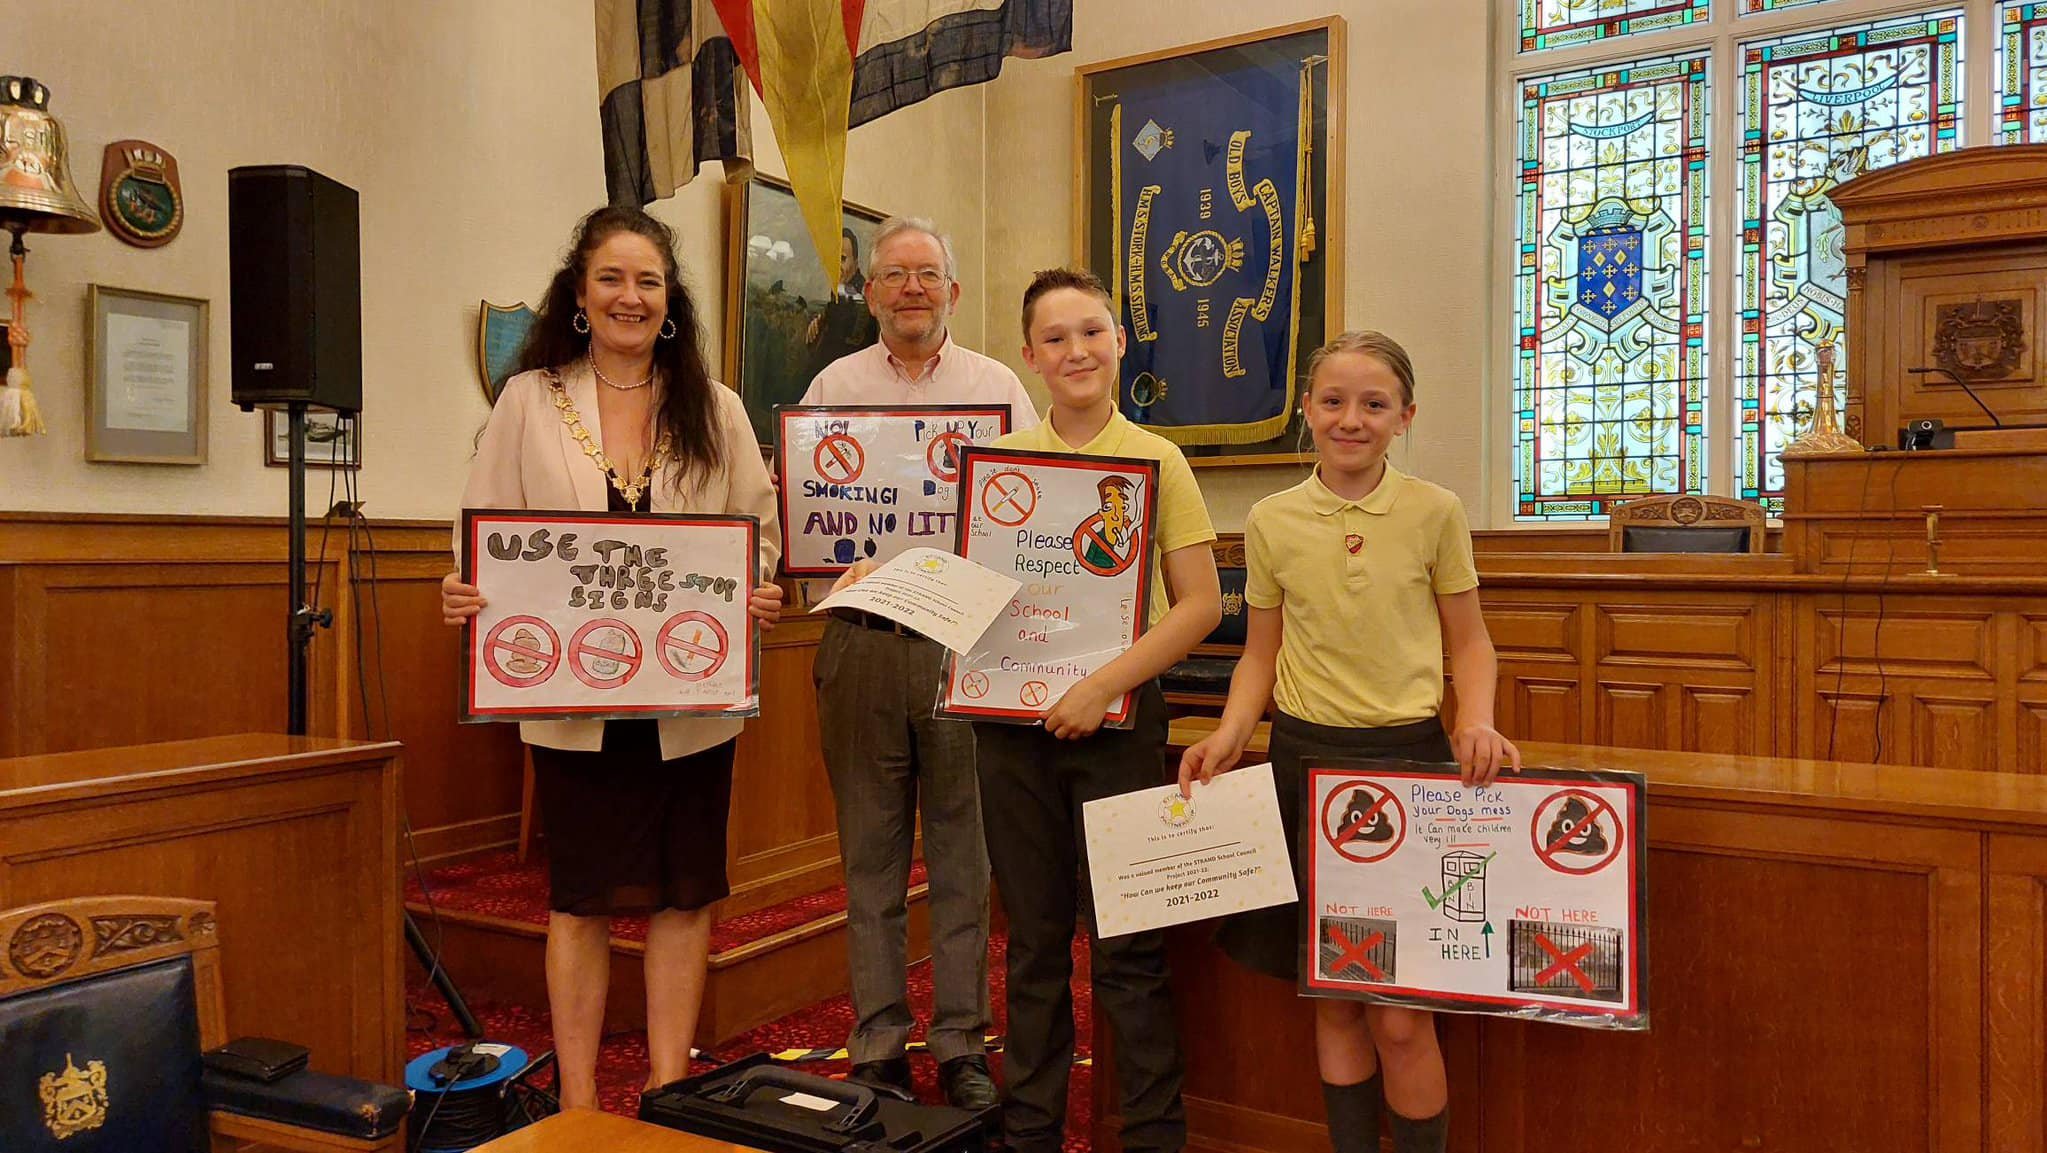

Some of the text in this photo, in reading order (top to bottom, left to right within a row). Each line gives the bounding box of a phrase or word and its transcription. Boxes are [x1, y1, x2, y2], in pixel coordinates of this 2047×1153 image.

[1812, 83, 1887, 105] LIVERPOOL
[1583, 120, 1642, 137] STOCKPORT
[1228, 140, 1247, 205] OLD BOYS
[1199, 188, 1212, 220] 1939
[1255, 183, 1281, 318] CAPTAIN WALKER'S
[1197, 298, 1210, 328] 1945
[1223, 300, 1249, 374] ASSOCIATION
[802, 479, 899, 506] SMOKING!
[803, 510, 957, 537] AND NO LIT
[487, 528, 669, 568] USE THE
[1016, 529, 1074, 551] Please
[1015, 554, 1081, 578] Respect
[569, 564, 738, 603] THREE STOP
[1026, 581, 1066, 597] our
[568, 585, 669, 613] SIGNS
[1010, 599, 1069, 621] School
[1018, 626, 1050, 643] and
[1000, 656, 1087, 677] Community
[1411, 783, 1504, 803] Please Pick
[1413, 804, 1512, 822] your Dogs mess
[1477, 823, 1512, 834] children
[1216, 851, 1235, 861] School
[1197, 871, 1238, 886] Community
[1165, 888, 1220, 908] 2021-2022
[1325, 902, 1394, 917] NOT HERE
[1515, 905, 1599, 923] NOT HERE
[1428, 927, 1459, 942] IN
[1441, 943, 1481, 961] HERE
